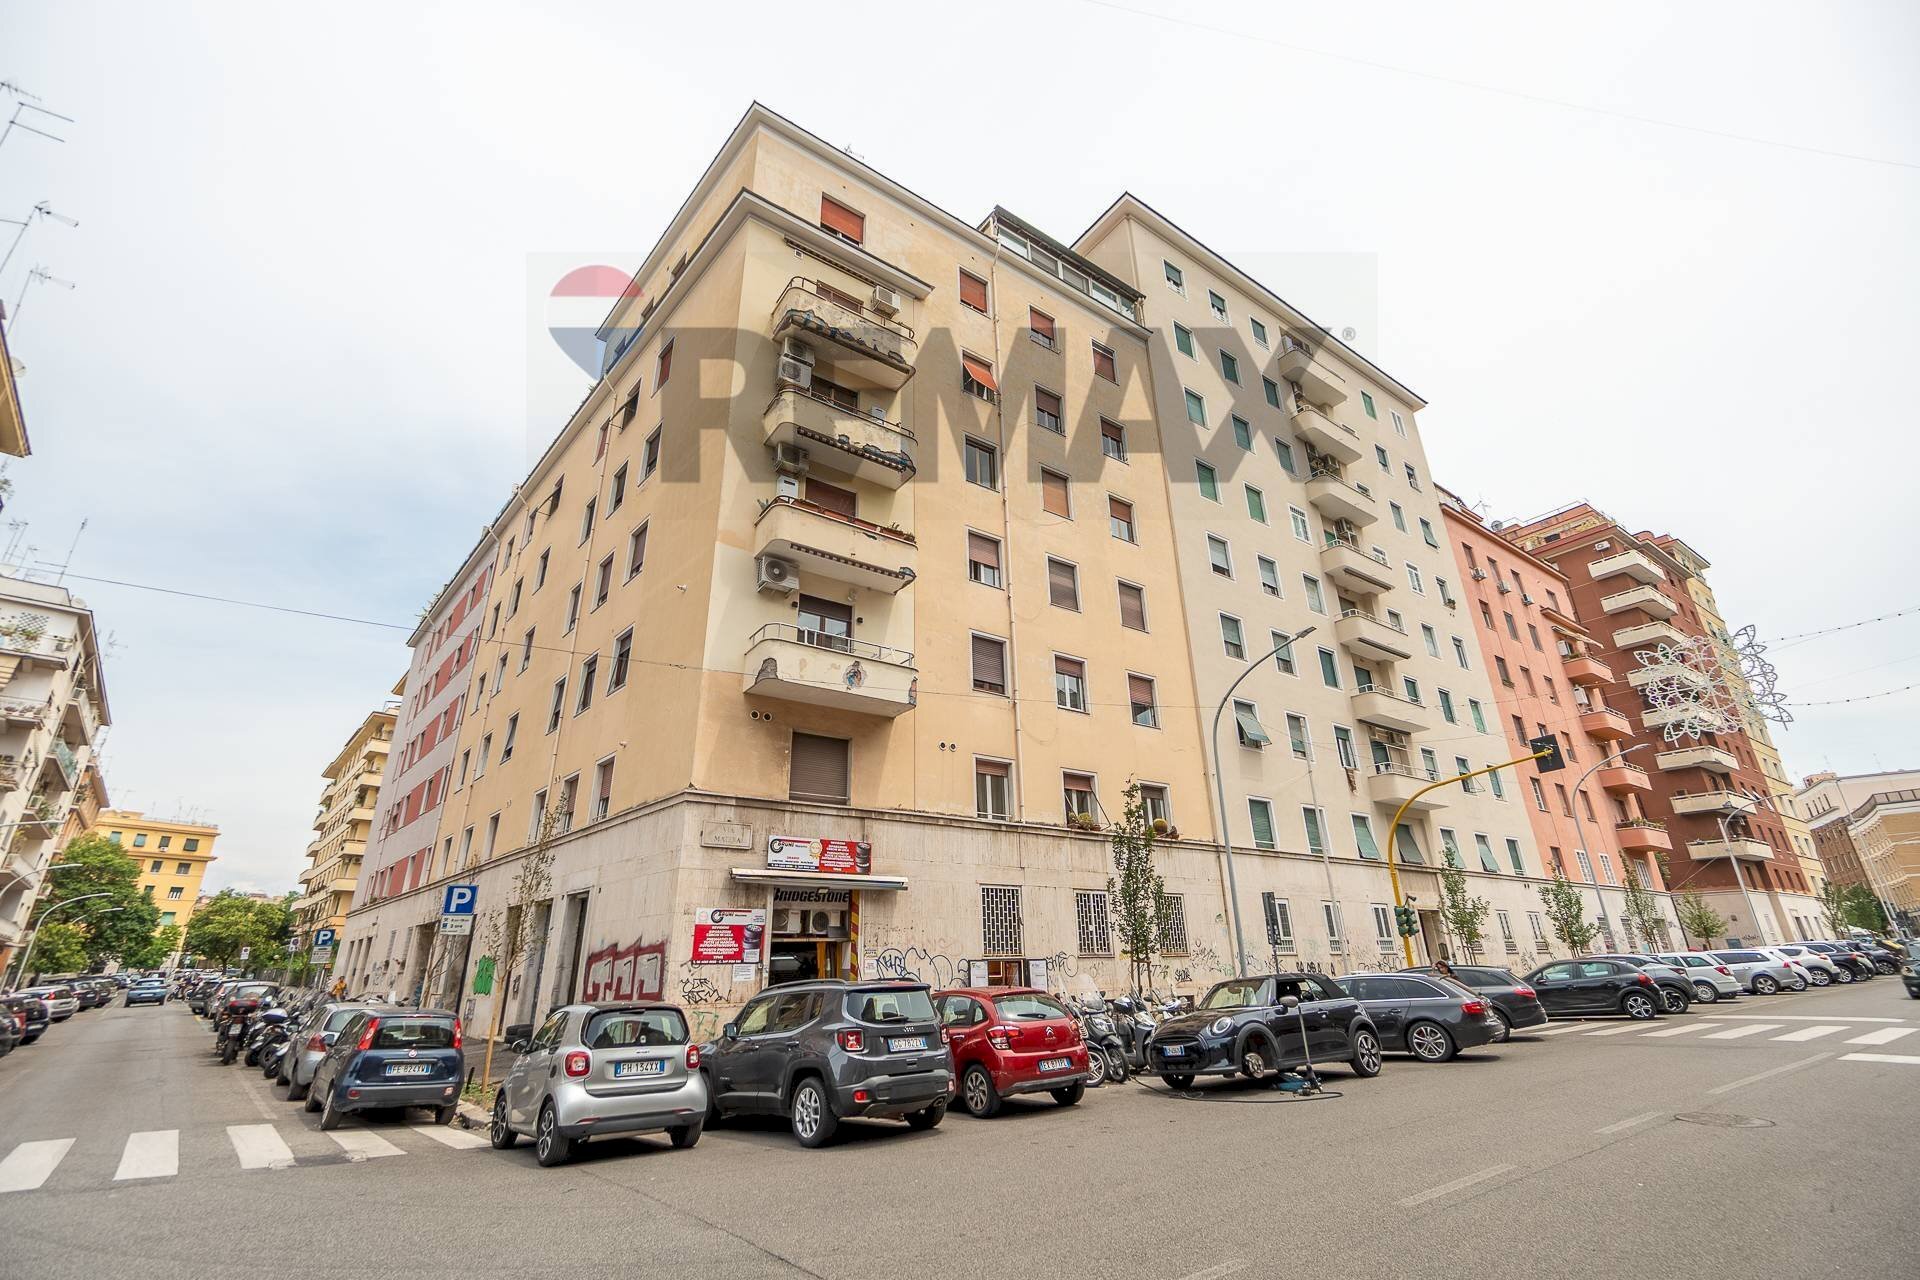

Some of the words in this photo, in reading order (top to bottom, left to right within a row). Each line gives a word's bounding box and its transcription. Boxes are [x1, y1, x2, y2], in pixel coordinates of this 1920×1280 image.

[449, 887, 472, 912] P
[773, 888, 850, 903] BRIDGESTONE
[317, 931, 331, 945] P
[622, 1063, 633, 1073] FH
[635, 1061, 659, 1072] 134XX
